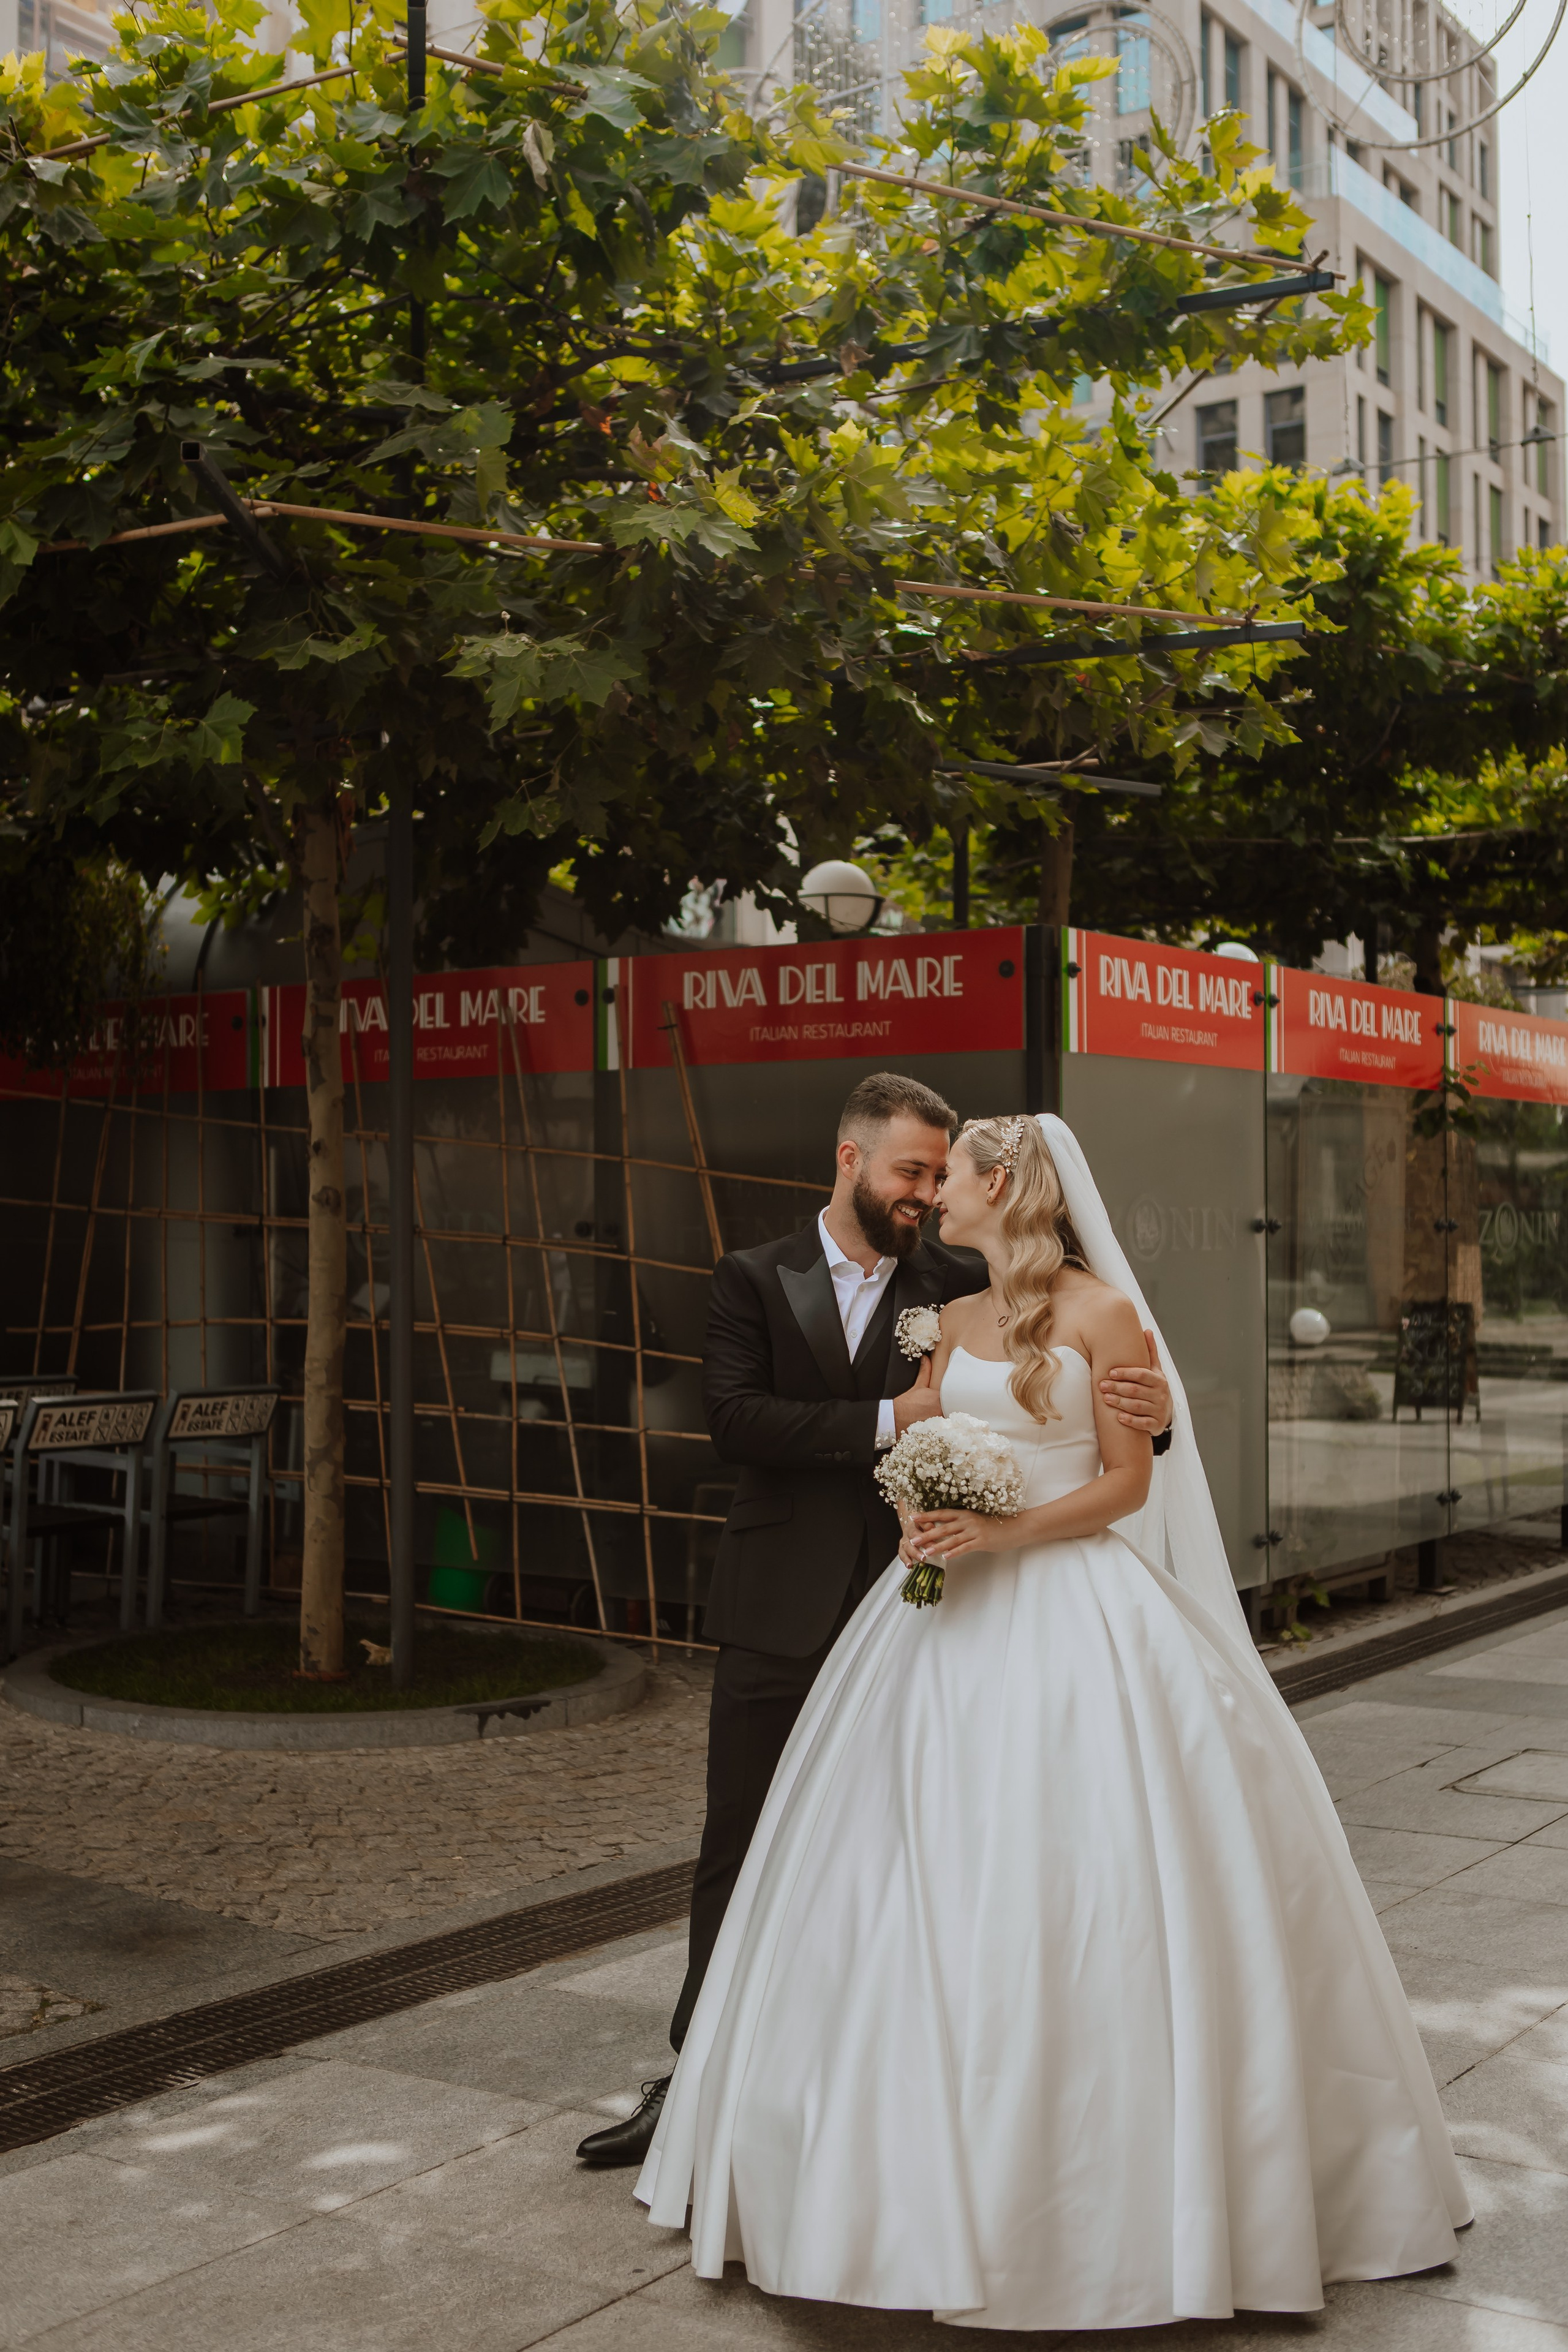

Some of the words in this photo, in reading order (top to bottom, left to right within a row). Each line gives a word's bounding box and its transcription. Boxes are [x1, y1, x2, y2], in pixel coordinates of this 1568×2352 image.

[683, 967, 767, 1009] RIVA
[779, 962, 844, 1005] DEL
[857, 955, 963, 1001] MARE
[1099, 954, 1152, 1003] RIVA
[1156, 965, 1194, 1010] DEL
[1198, 972, 1252, 1019] MARE
[339, 996, 388, 1033] IVA
[460, 986, 546, 1028] MARE
[1308, 989, 1348, 1032] RIVA
[1351, 998, 1379, 1038] DEL
[1381, 1004, 1422, 1046] MARE
[750, 1024, 798, 1042] ITALIAN
[802, 1020, 892, 1040] RESTAURANT
[1141, 1022, 1169, 1041] ITALIAN
[1171, 1026, 1218, 1047] RESTAURANT
[1479, 1020, 1509, 1058] RIVA
[1511, 1027, 1532, 1061] DEL
[1536, 1032, 1566, 1066] MARE
[417, 1044, 489, 1062] RESTAURANT
[1340, 1047, 1361, 1064] ITALIAN
[1362, 1051, 1396, 1070] RESTAURANT
[1479, 1201, 1561, 1256] ZONIN
[55, 1410, 97, 1427] ALEF
[192, 1401, 228, 1417] ALEF
[49, 1428, 92, 1444] ESTATE
[187, 1418, 224, 1431] ESTATE
